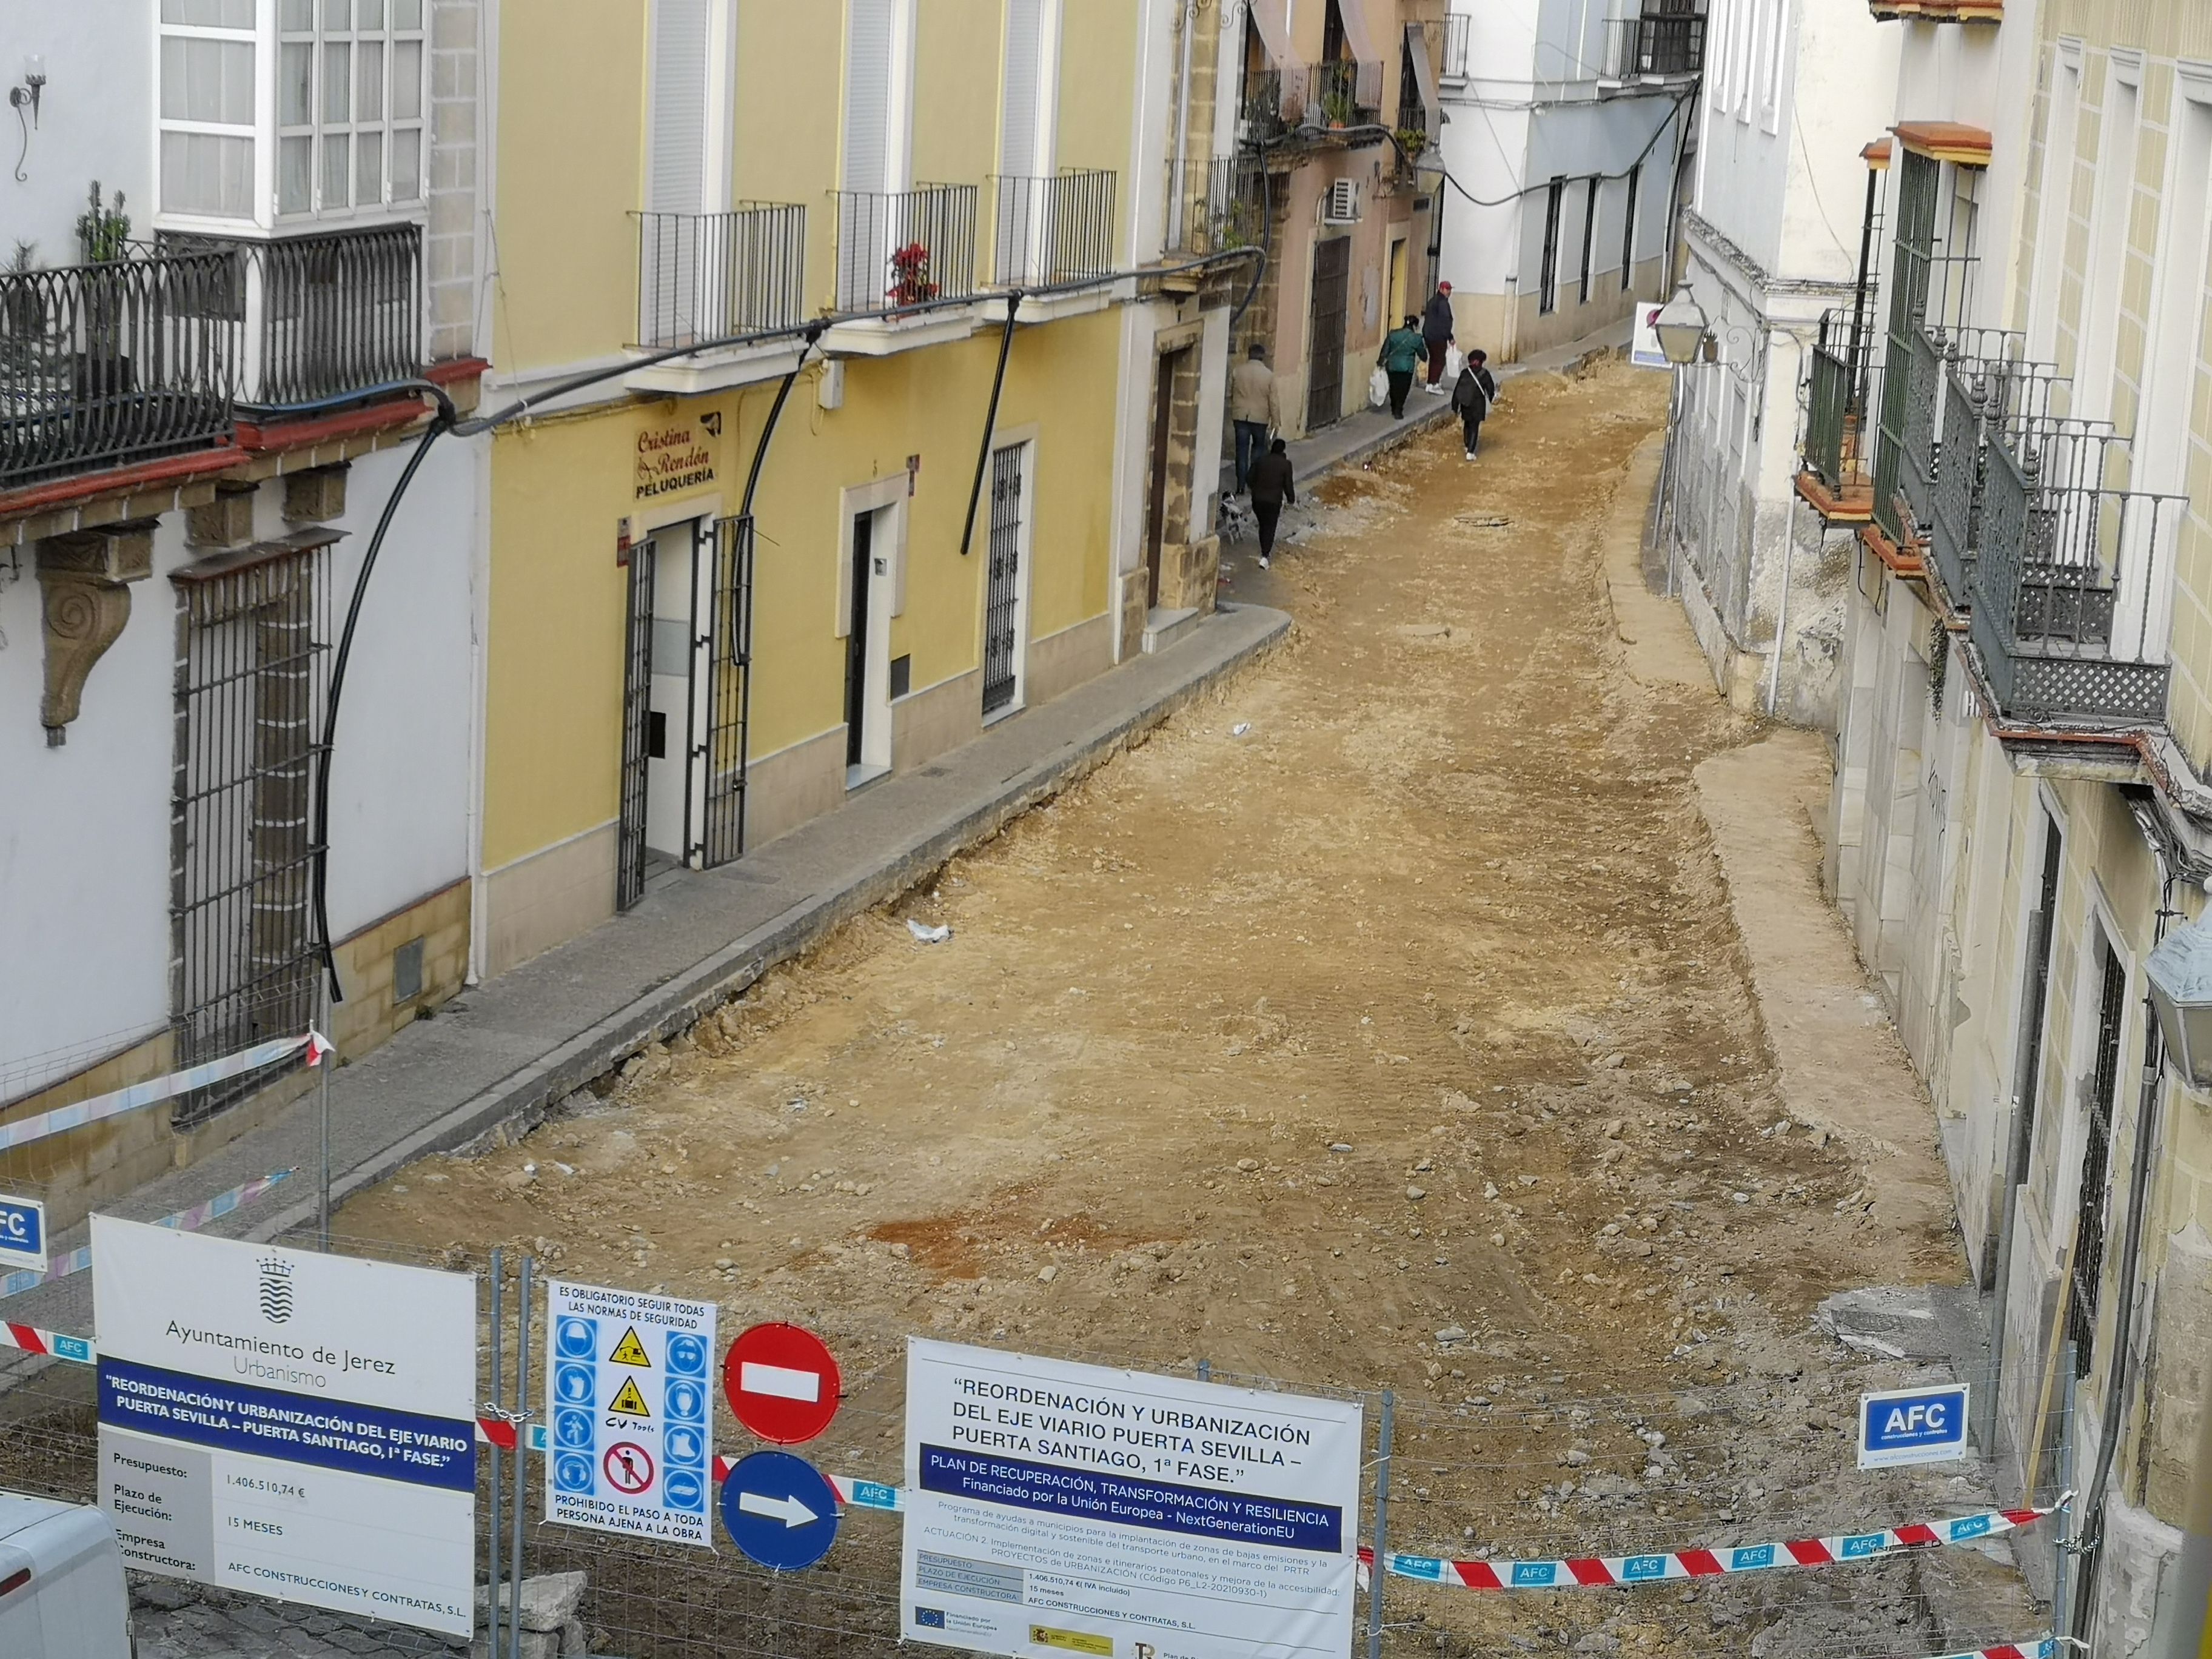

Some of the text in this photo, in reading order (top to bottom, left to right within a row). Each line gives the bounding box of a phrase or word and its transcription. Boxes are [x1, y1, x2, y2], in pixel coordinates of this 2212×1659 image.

[638, 428, 690, 453] Cristina
[636, 467, 714, 499] PELUQUERÍA
[560, 1287, 705, 1316] ES OBLIGATORIO SEGUIR TODAS
[569, 1301, 697, 1329] LAS NORMAS DE SEGURIDAD
[59, 1340, 82, 1353] AFC
[166, 1320, 395, 1375] Ayuntamiento de Jerez
[234, 1356, 326, 1387] Urbanismo
[116, 1395, 170, 1418] PUERTA
[173, 1408, 230, 1430] SEVILLA
[243, 1421, 300, 1442] PUERTA
[303, 1432, 385, 1460] SANTIAGO,
[225, 1401, 235, 1412] Y
[238, 1402, 354, 1433] URBANIZACIÓN
[357, 1423, 387, 1439] DEL
[390, 1429, 413, 1445] EJE
[414, 1433, 468, 1452] VIARIO
[605, 1418, 628, 1429] CV
[1132, 1406, 1145, 1421] Y
[1152, 1408, 1310, 1446] URBANIZACIÓN
[1884, 1403, 1946, 1433] AFC
[954, 1402, 1285, 1467] DEL EJE VIARIO PUERTA SEVILLA
[953, 1426, 1031, 1452] PUERTA
[1037, 1439, 1146, 1473] SANTIAGO,
[1154, 1458, 1171, 1473] 1ª
[113, 1453, 187, 1478] Presupuesto:
[115, 1484, 162, 1504] Plazo de
[227, 1475, 306, 1498] 1.406.510,74 €
[860, 1486, 887, 1500] AFC
[931, 1455, 1329, 1527] PLAN DE RECUPERACIÓN, TRANSFORMACIÓN Y RESILIENCIA
[115, 1499, 172, 1521] Ejecución:
[555, 1494, 703, 1527] PROHIBIDO EL PASO A TODA
[963, 1477, 1295, 1539] Financiado por la Unión Europea NextGenerationEU
[228, 1517, 283, 1535] 15 MESES
[557, 1508, 703, 1541] PERSONA AJENA A LA OBRA
[938, 1501, 980, 1516] Programa
[996, 1513, 1027, 1524] ayudas
[1037, 1520, 1084, 1533] municipios
[1087, 1528, 1106, 1538] para
[1109, 1530, 1116, 1539] la
[1119, 1533, 1176, 1547] implantación
[1193, 1546, 1219, 1554] zonas
[1222, 1548, 1234, 1557] de
[1236, 1549, 1261, 1560] bajas
[1263, 1555, 1309, 1566] emisiones
[1319, 1560, 1327, 1568] la
[1957, 1520, 1983, 1533] AFC
[954, 1515, 1019, 1532] transformación
[1021, 1527, 1048, 1537] digital
[1059, 1533, 1104, 1546] sostenible
[1106, 1540, 1119, 1549] del
[1122, 1543, 1169, 1557] transporte
[1171, 1551, 1206, 1563] urbano,
[1233, 1560, 1261, 1569] marco
[1264, 1563, 1278, 1572] del
[1284, 1566, 1310, 1575] PRTR
[1740, 1549, 1767, 1561] AFC
[1850, 1538, 1878, 1550] AFC
[919, 1553, 972, 1569] PRESUPUESTO
[923, 1526, 979, 1543] ACTUACIÓN
[991, 1538, 1061, 1557] Implementación
[1063, 1550, 1074, 1559] de
[1077, 1554, 1102, 1564] zonas
[1113, 1558, 1157, 1572] itinerarios
[1159, 1567, 1209, 1580] peatonales
[1220, 1576, 1251, 1587] mejora
[1268, 1581, 1276, 1589] la
[1278, 1584, 1340, 1597] accesibilidad:
[991, 1548, 1048, 1564] PROYECTOS
[1050, 1558, 1062, 1567] de
[1064, 1560, 1137, 1578] URBANIZACIÓN
[1139, 1572, 1176, 1585] (Código
[1520, 1567, 1548, 1578] AFC
[1631, 1560, 1659, 1572] AFC
[228, 1562, 466, 1618] AFC CONSTRUCCIONES Y CONTRATAS, S.L.
[918, 1578, 953, 1590] EMPRESA
[919, 1566, 943, 1576] PLAZO
[957, 1573, 1000, 1586] EJECUCIÓN
[1029, 1573, 1074, 1586] 1.406.510,74
[1085, 1581, 1096, 1590] IVA
[1040, 1588, 1064, 1597] meses
[1046, 1600, 1120, 1618] CONSTRUCCIONES
[1129, 1613, 1179, 1628] CONTRATAS,
